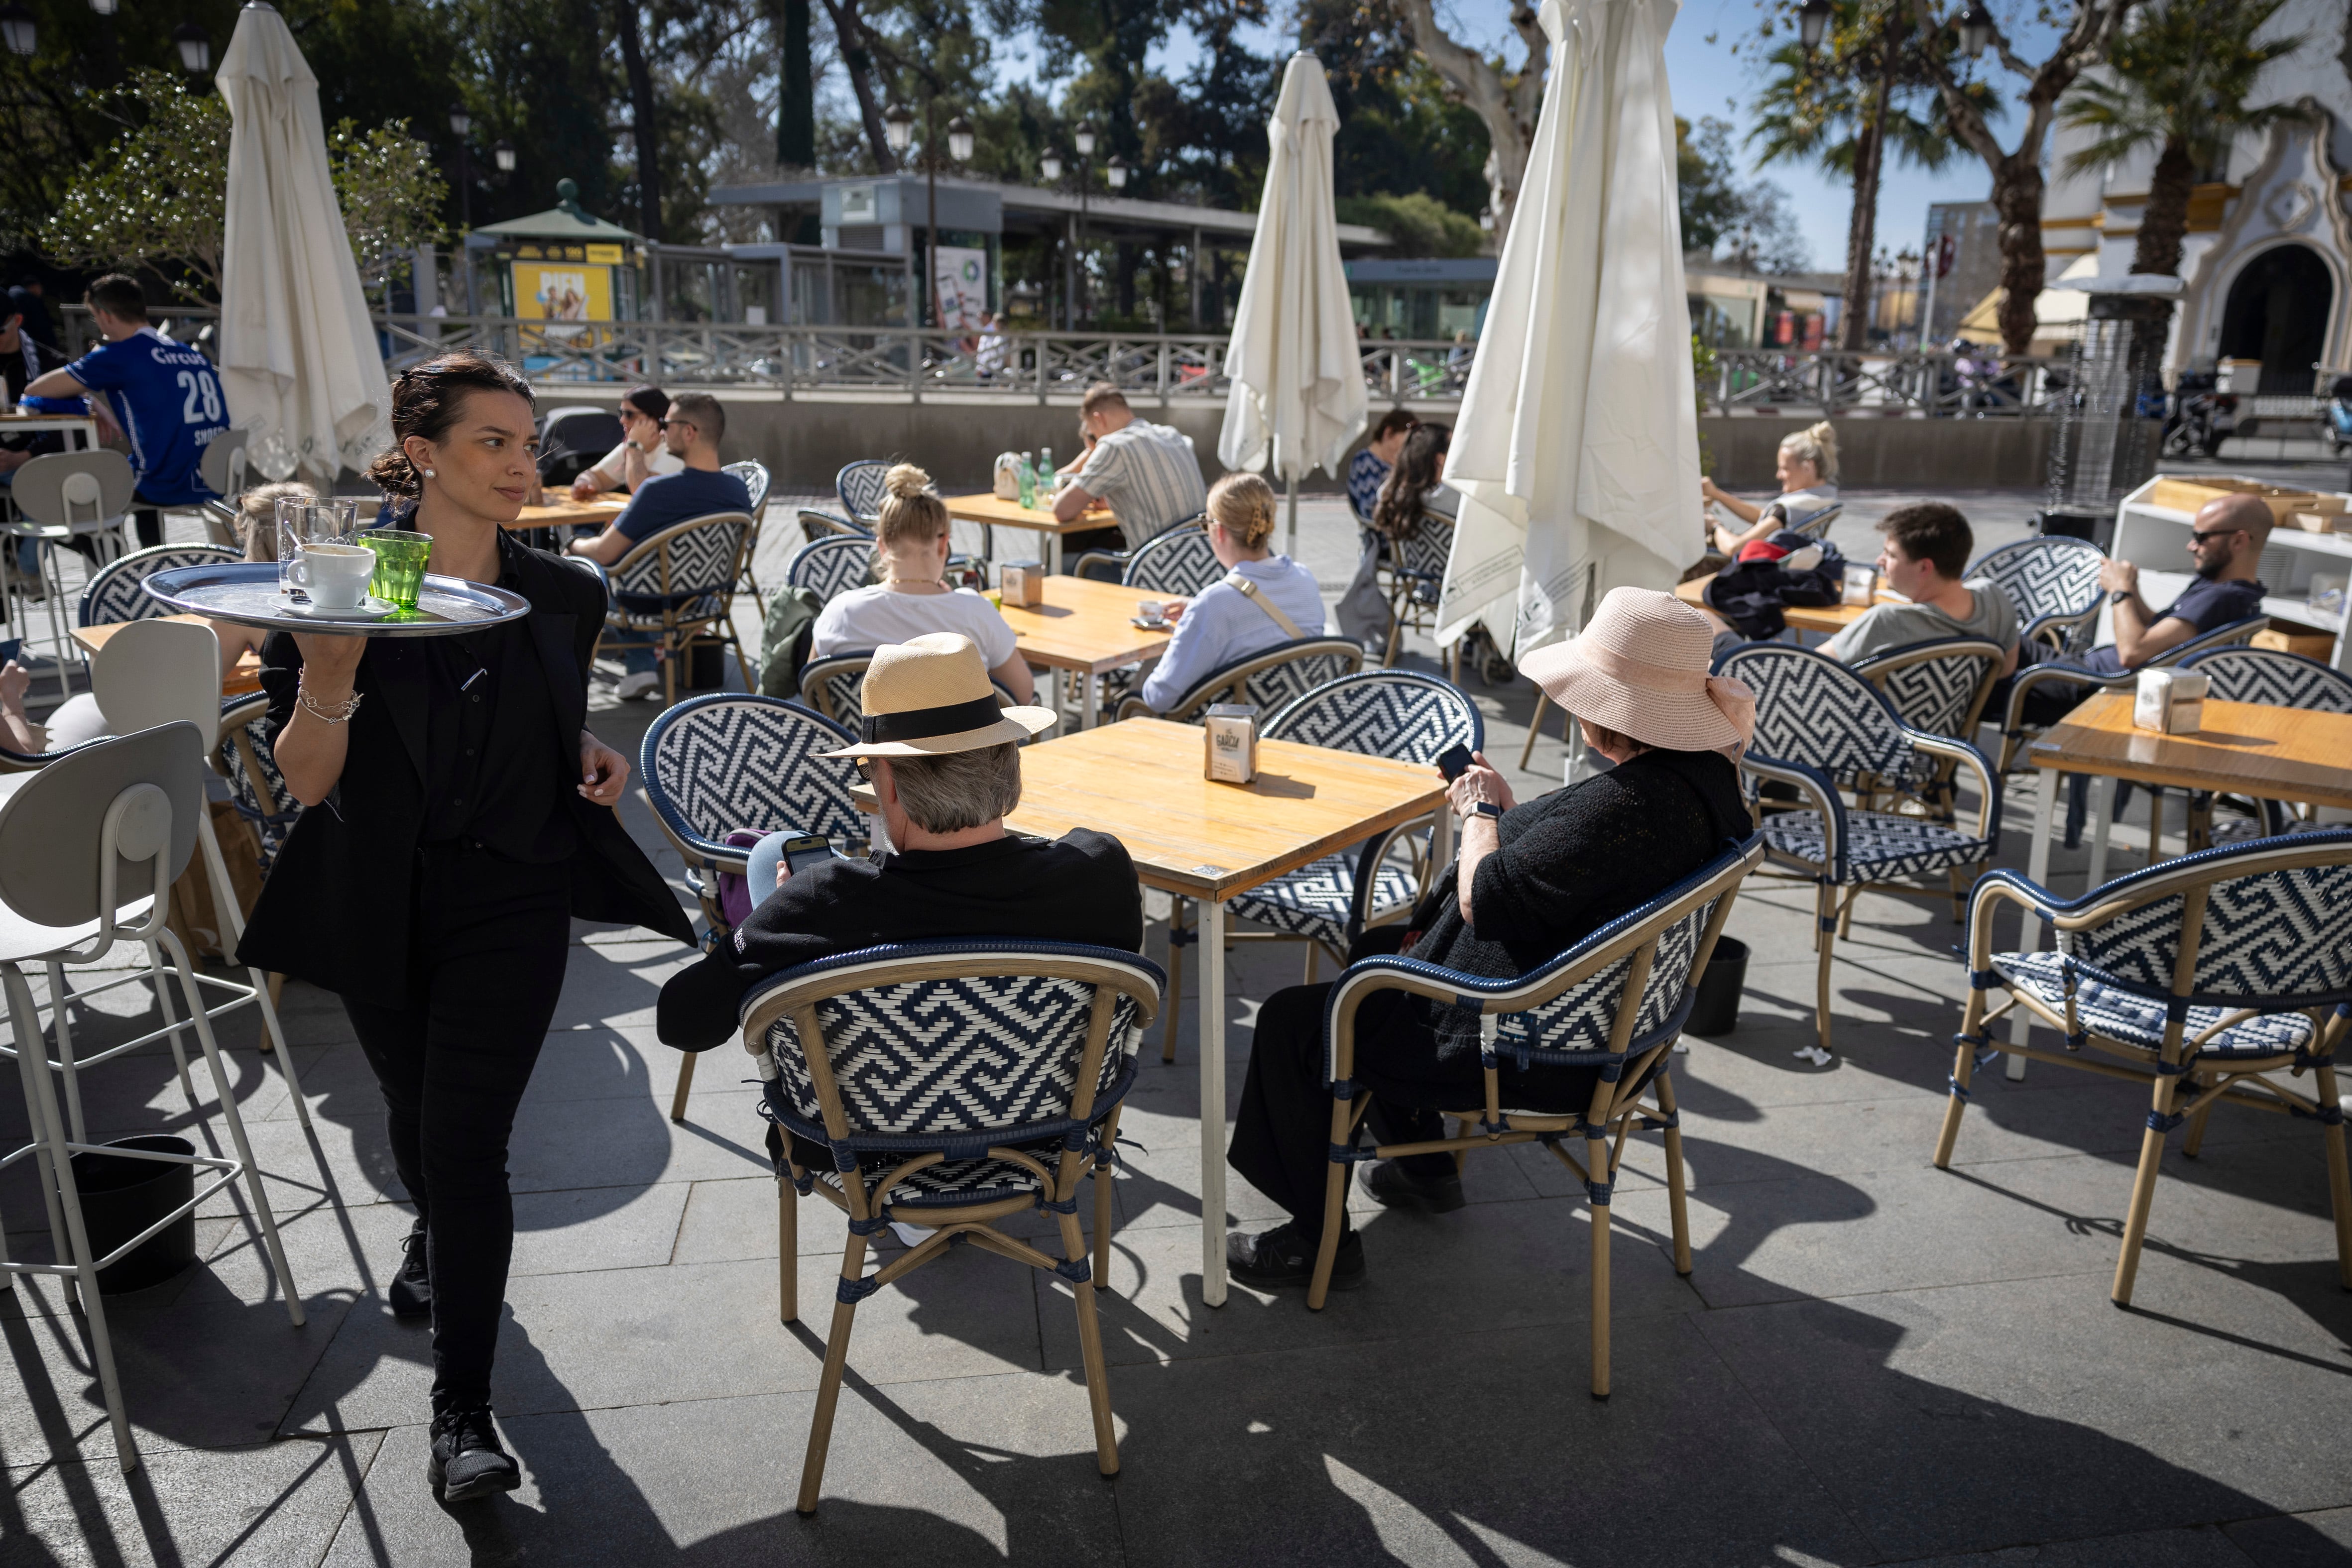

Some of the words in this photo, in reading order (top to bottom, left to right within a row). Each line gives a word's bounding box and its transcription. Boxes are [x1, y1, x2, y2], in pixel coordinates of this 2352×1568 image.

[151, 347, 207, 366] Circus
[177, 370, 221, 424] 28
[737, 927, 746, 950] BOSS
